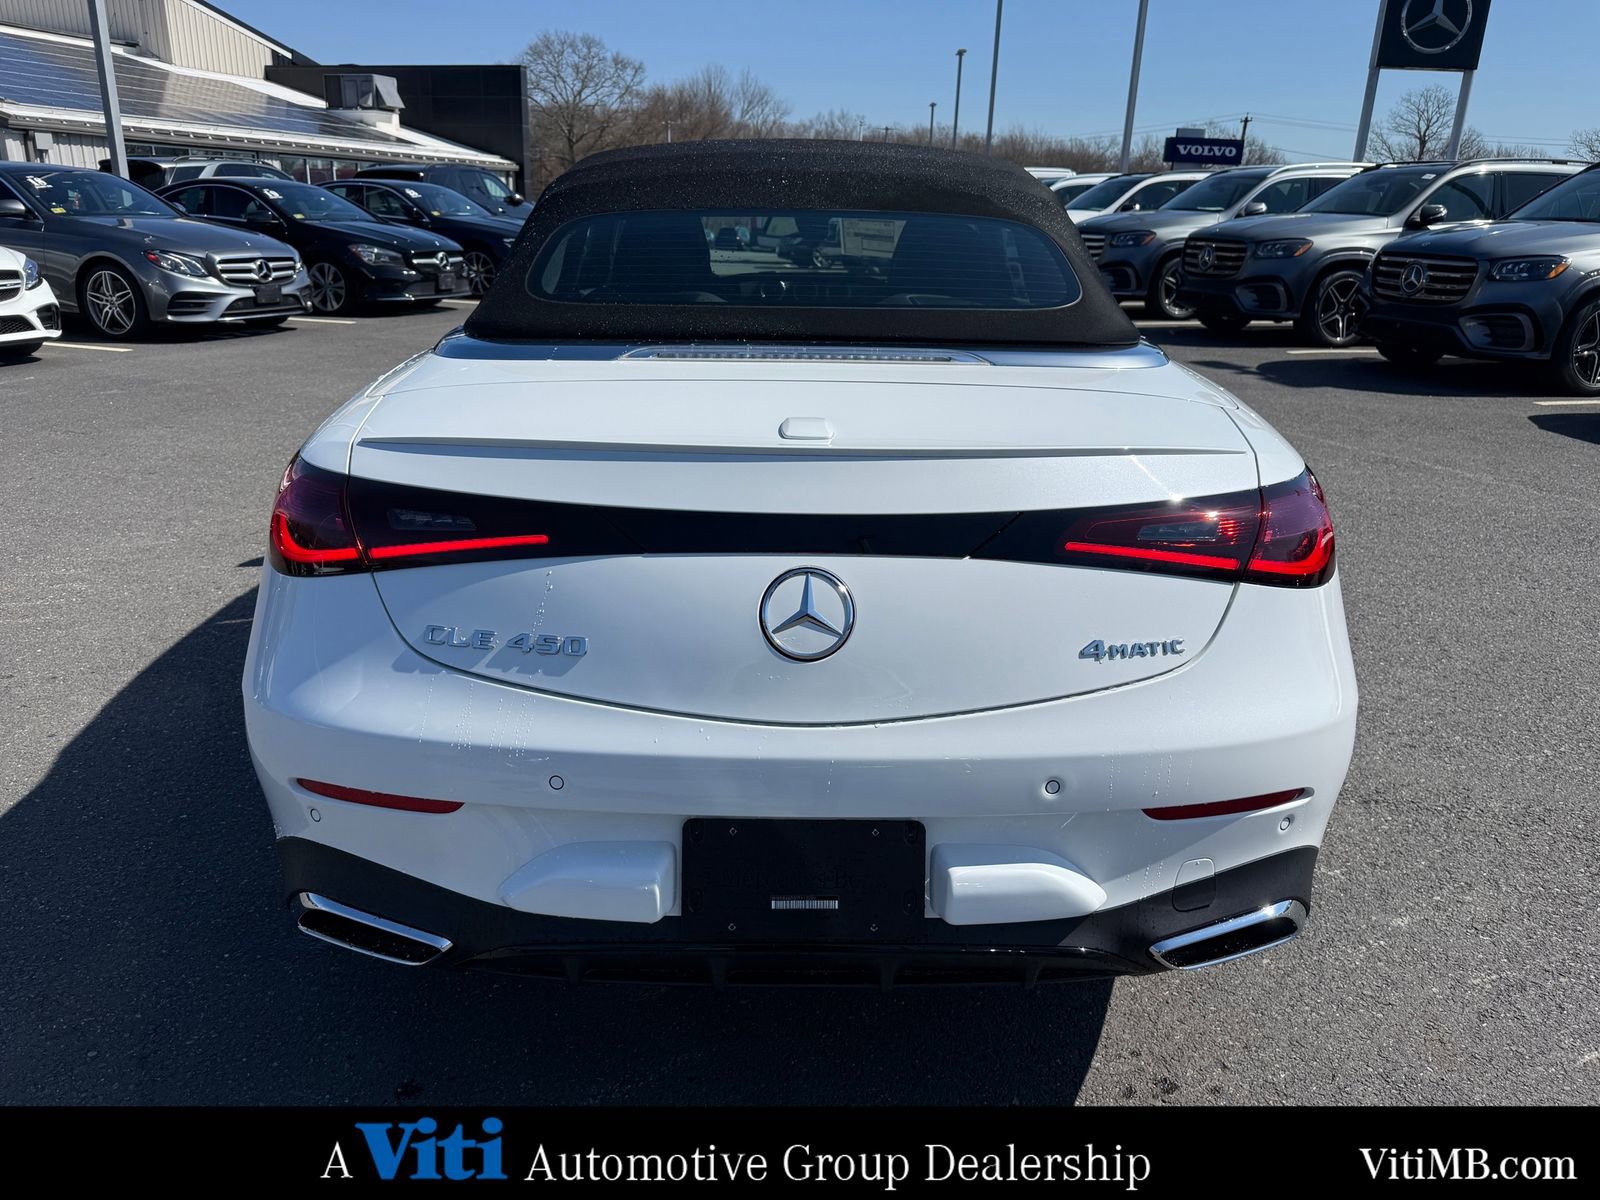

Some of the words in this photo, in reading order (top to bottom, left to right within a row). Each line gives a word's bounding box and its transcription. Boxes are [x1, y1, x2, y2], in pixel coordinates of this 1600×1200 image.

[1176, 144, 1237, 157] VOLVO
[423, 624, 499, 651] CLE
[506, 632, 589, 657] 450
[1078, 638, 1185, 662] 4MATIC
